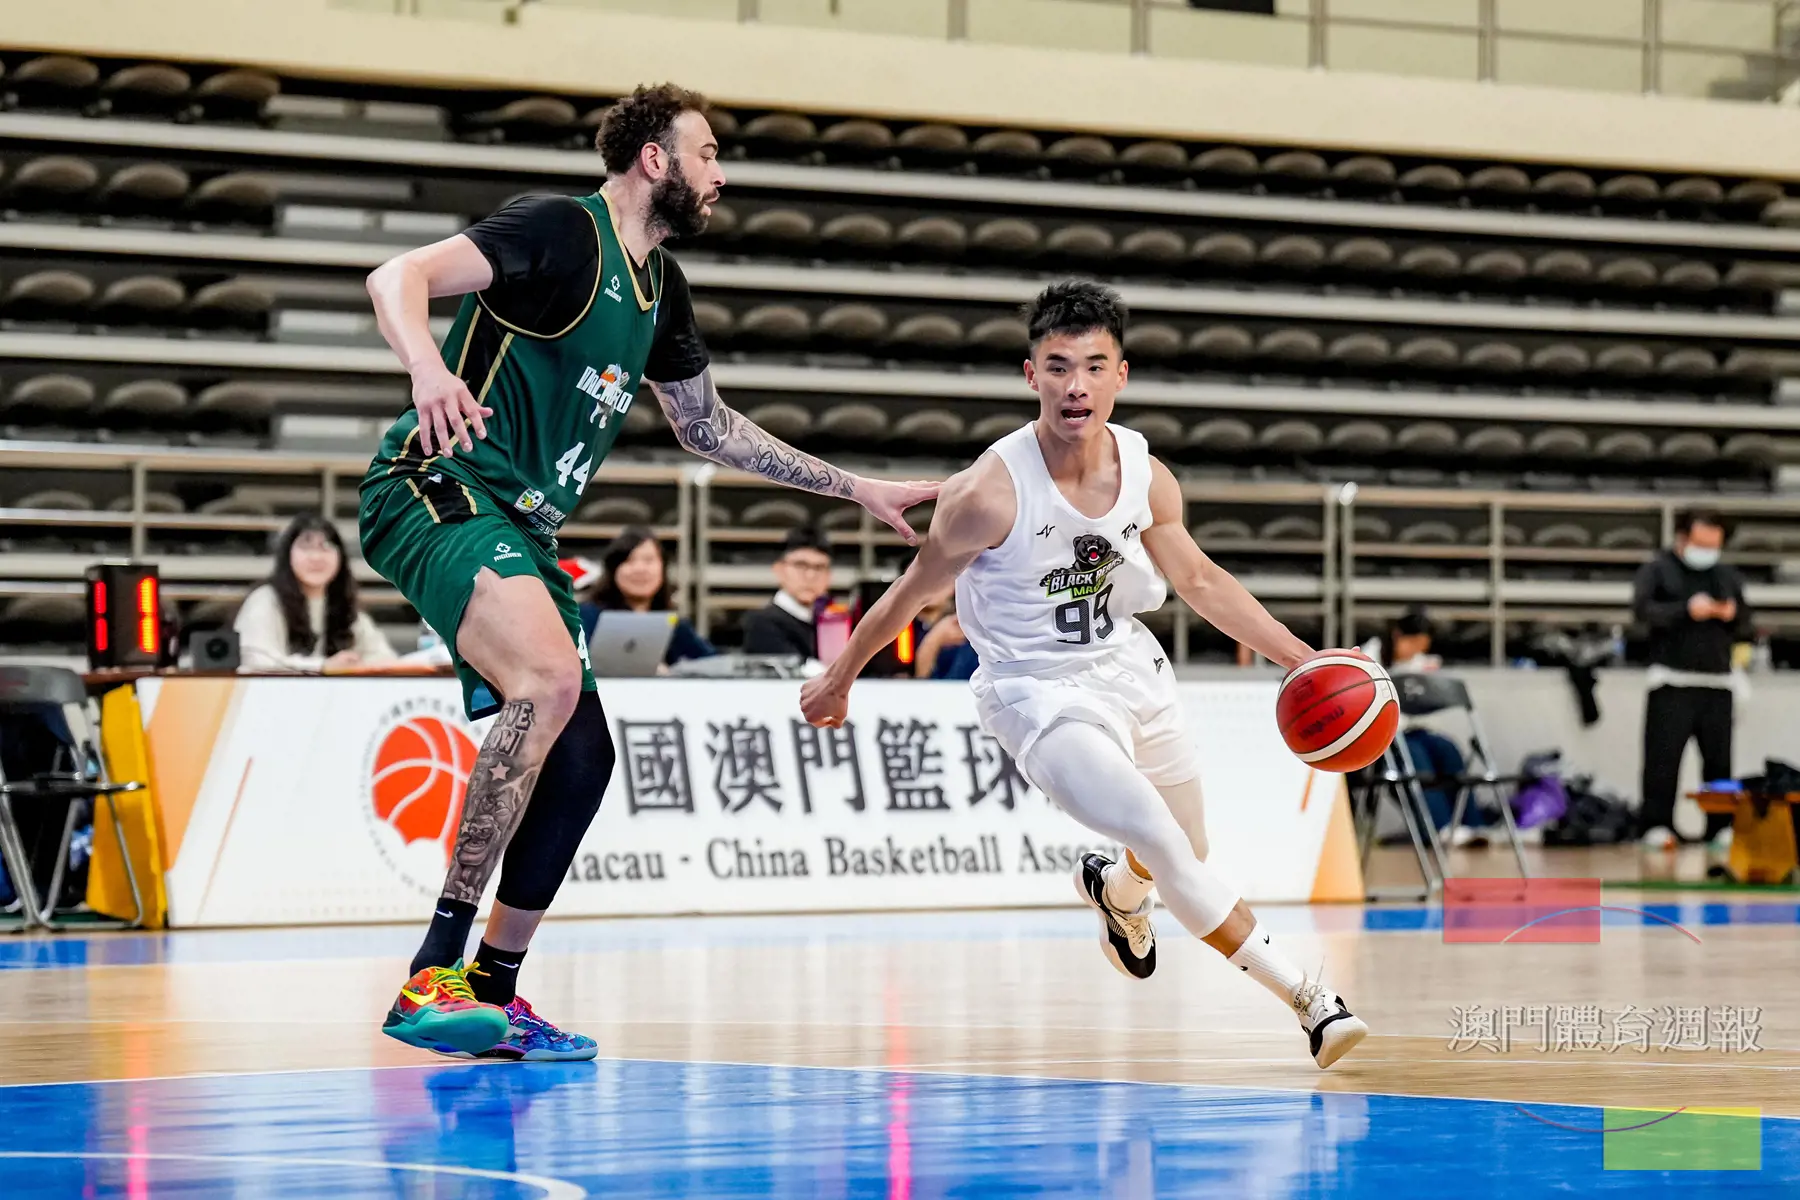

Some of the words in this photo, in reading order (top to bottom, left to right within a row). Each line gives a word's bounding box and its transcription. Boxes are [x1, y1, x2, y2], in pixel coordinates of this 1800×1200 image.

[556, 441, 594, 496] 44
[753, 445, 785, 480] One
[1050, 573, 1094, 593] BLACK
[706, 837, 810, 880] China
[824, 835, 1002, 877] Basketball
